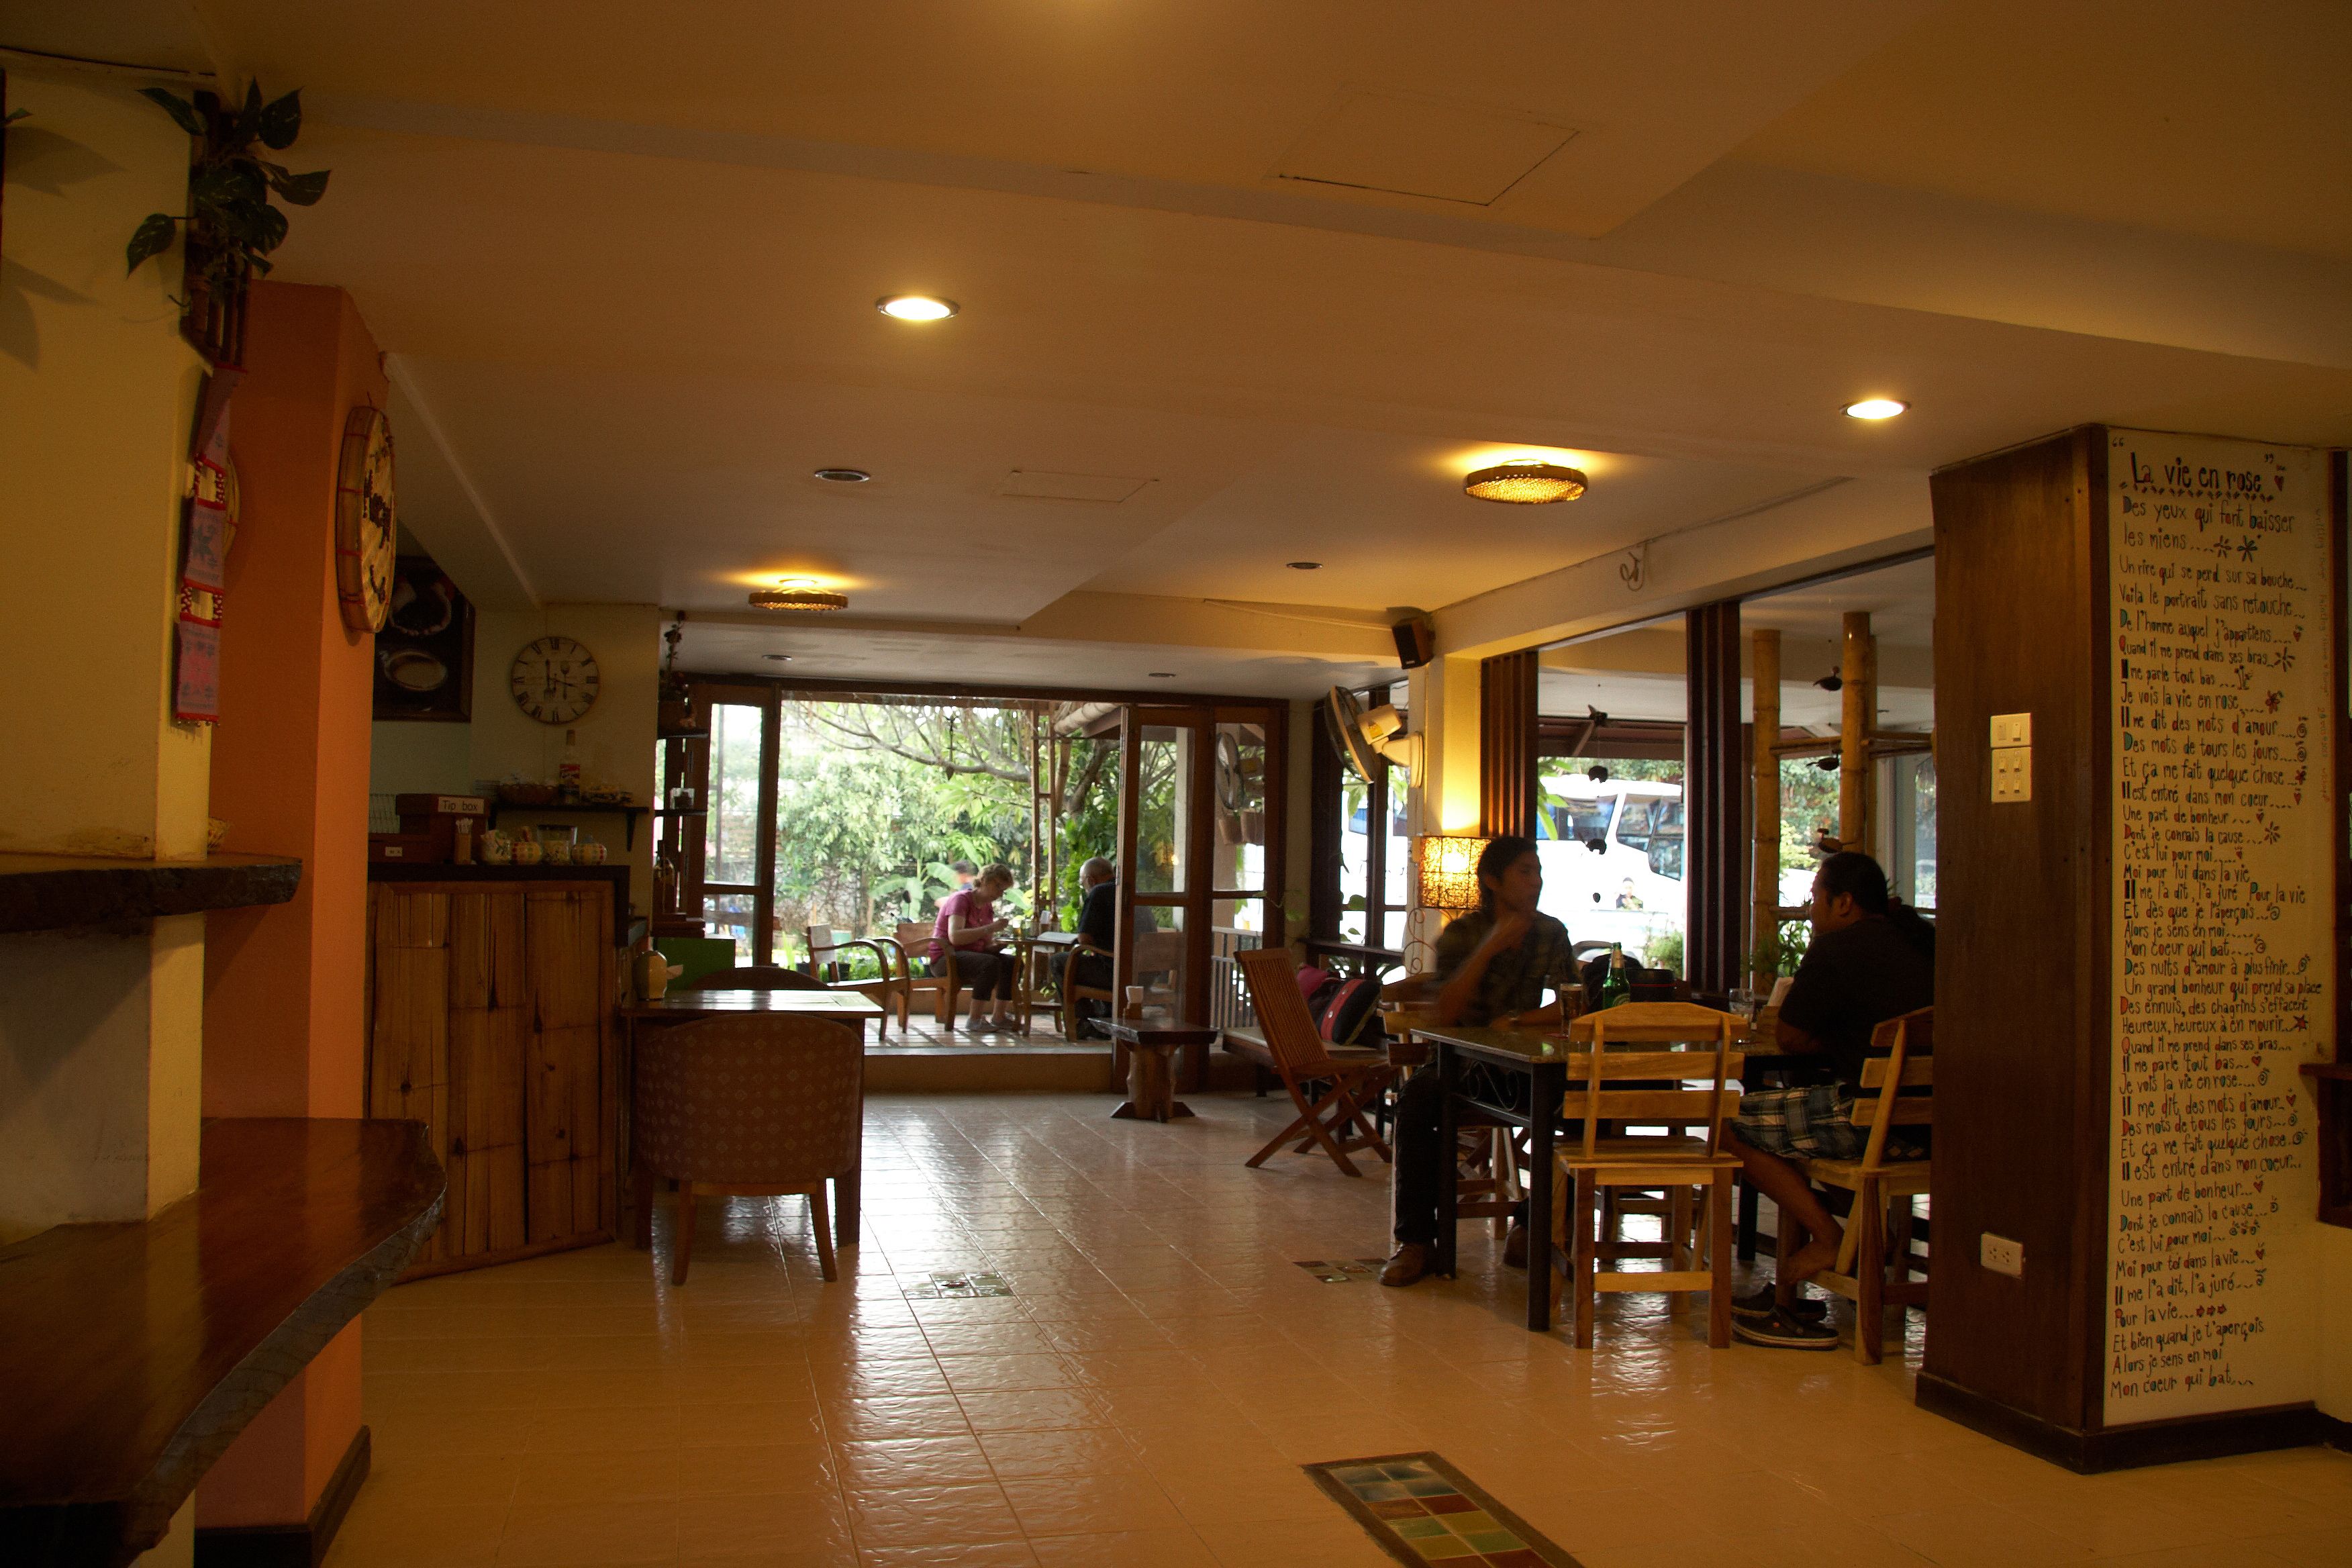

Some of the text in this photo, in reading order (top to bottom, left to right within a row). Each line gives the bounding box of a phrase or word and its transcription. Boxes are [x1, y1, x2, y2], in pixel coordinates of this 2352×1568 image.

[2164, 457, 2191, 488] vie
[2198, 467, 2218, 489] en
[2226, 471, 2261, 492] rose
[2123, 495, 2145, 516] Des
[2153, 503, 2186, 522] yeux
[2195, 503, 2212, 532] qui
[2249, 503, 2294, 533] baisser
[2124, 522, 2143, 546] les
[2119, 555, 2134, 573] Un
[2159, 563, 2174, 585] qui
[2182, 567, 2192, 579] se
[2196, 564, 2219, 587] perd
[2226, 569, 2242, 583] sur
[2247, 571, 2256, 584] sa
[2150, 583, 2237, 614] le portrait sans
[2120, 609, 2133, 632] De
[2121, 681, 2210, 709] Je vois la vie en
[2172, 711, 2189, 730] des
[2197, 712, 2223, 732] mots
[2124, 732, 2145, 752] Des
[2151, 735, 2176, 754] mots
[2184, 735, 2195, 754] de
[2233, 737, 2245, 758] les
[2123, 756, 2136, 777] Et
[2183, 758, 2202, 779] fait
[443, 799, 477, 812] Tip box
[2186, 785, 2208, 804] dans
[2215, 792, 2233, 805] mon
[2123, 805, 2142, 821] Une
[2174, 806, 2186, 823] de
[2124, 863, 2250, 882] Moi pour dans vie
[2250, 882, 2269, 901] Pour
[2290, 885, 2305, 903] vie
[2124, 901, 2138, 920] Et
[2167, 906, 2187, 924] que
[2124, 922, 2189, 938] Alors sens
[2125, 940, 2145, 956] Mon
[2124, 959, 2144, 975] Des
[2124, 979, 2141, 995] Un
[2147, 979, 2175, 1000] grand
[2182, 979, 2224, 994] bonheur
[2120, 996, 2139, 1014] Des
[2189, 998, 2206, 1014] des
[2212, 999, 2255, 1018] chagrins
[2173, 1018, 2215, 1034] heureux
[2231, 1018, 2243, 1032] en
[2122, 1037, 2153, 1054] Quand
[2119, 1073, 2133, 1094] Je
[2179, 1073, 2192, 1087] vie
[2197, 1075, 2210, 1085] en
[2138, 1101, 2154, 1116] me
[2186, 1093, 2203, 1114] des
[2208, 1093, 2233, 1114] mots
[2122, 1113, 2236, 1136] Des mots tous les
[2121, 1138, 2135, 1159] Et
[2135, 1162, 2155, 1180] est
[2200, 1153, 2231, 1175] dans
[2237, 1159, 2256, 1171] mon
[2121, 1181, 2190, 1210] Une part de
[2163, 1205, 2202, 1224] connais
[2150, 1234, 2163, 1254] lui
[2166, 1235, 2188, 1252] pour
[2116, 1252, 2206, 1280] Moi pour dans
[2128, 1288, 2142, 1302] me
[2115, 1308, 2137, 1328] Pour
[2113, 1334, 2126, 1352] Et
[2130, 1331, 2153, 1350] bien
[2156, 1324, 2188, 1352] quand
[2113, 1349, 2222, 1375] Alors sens en moi
[2111, 1368, 2202, 1398] Mon coeur qui
